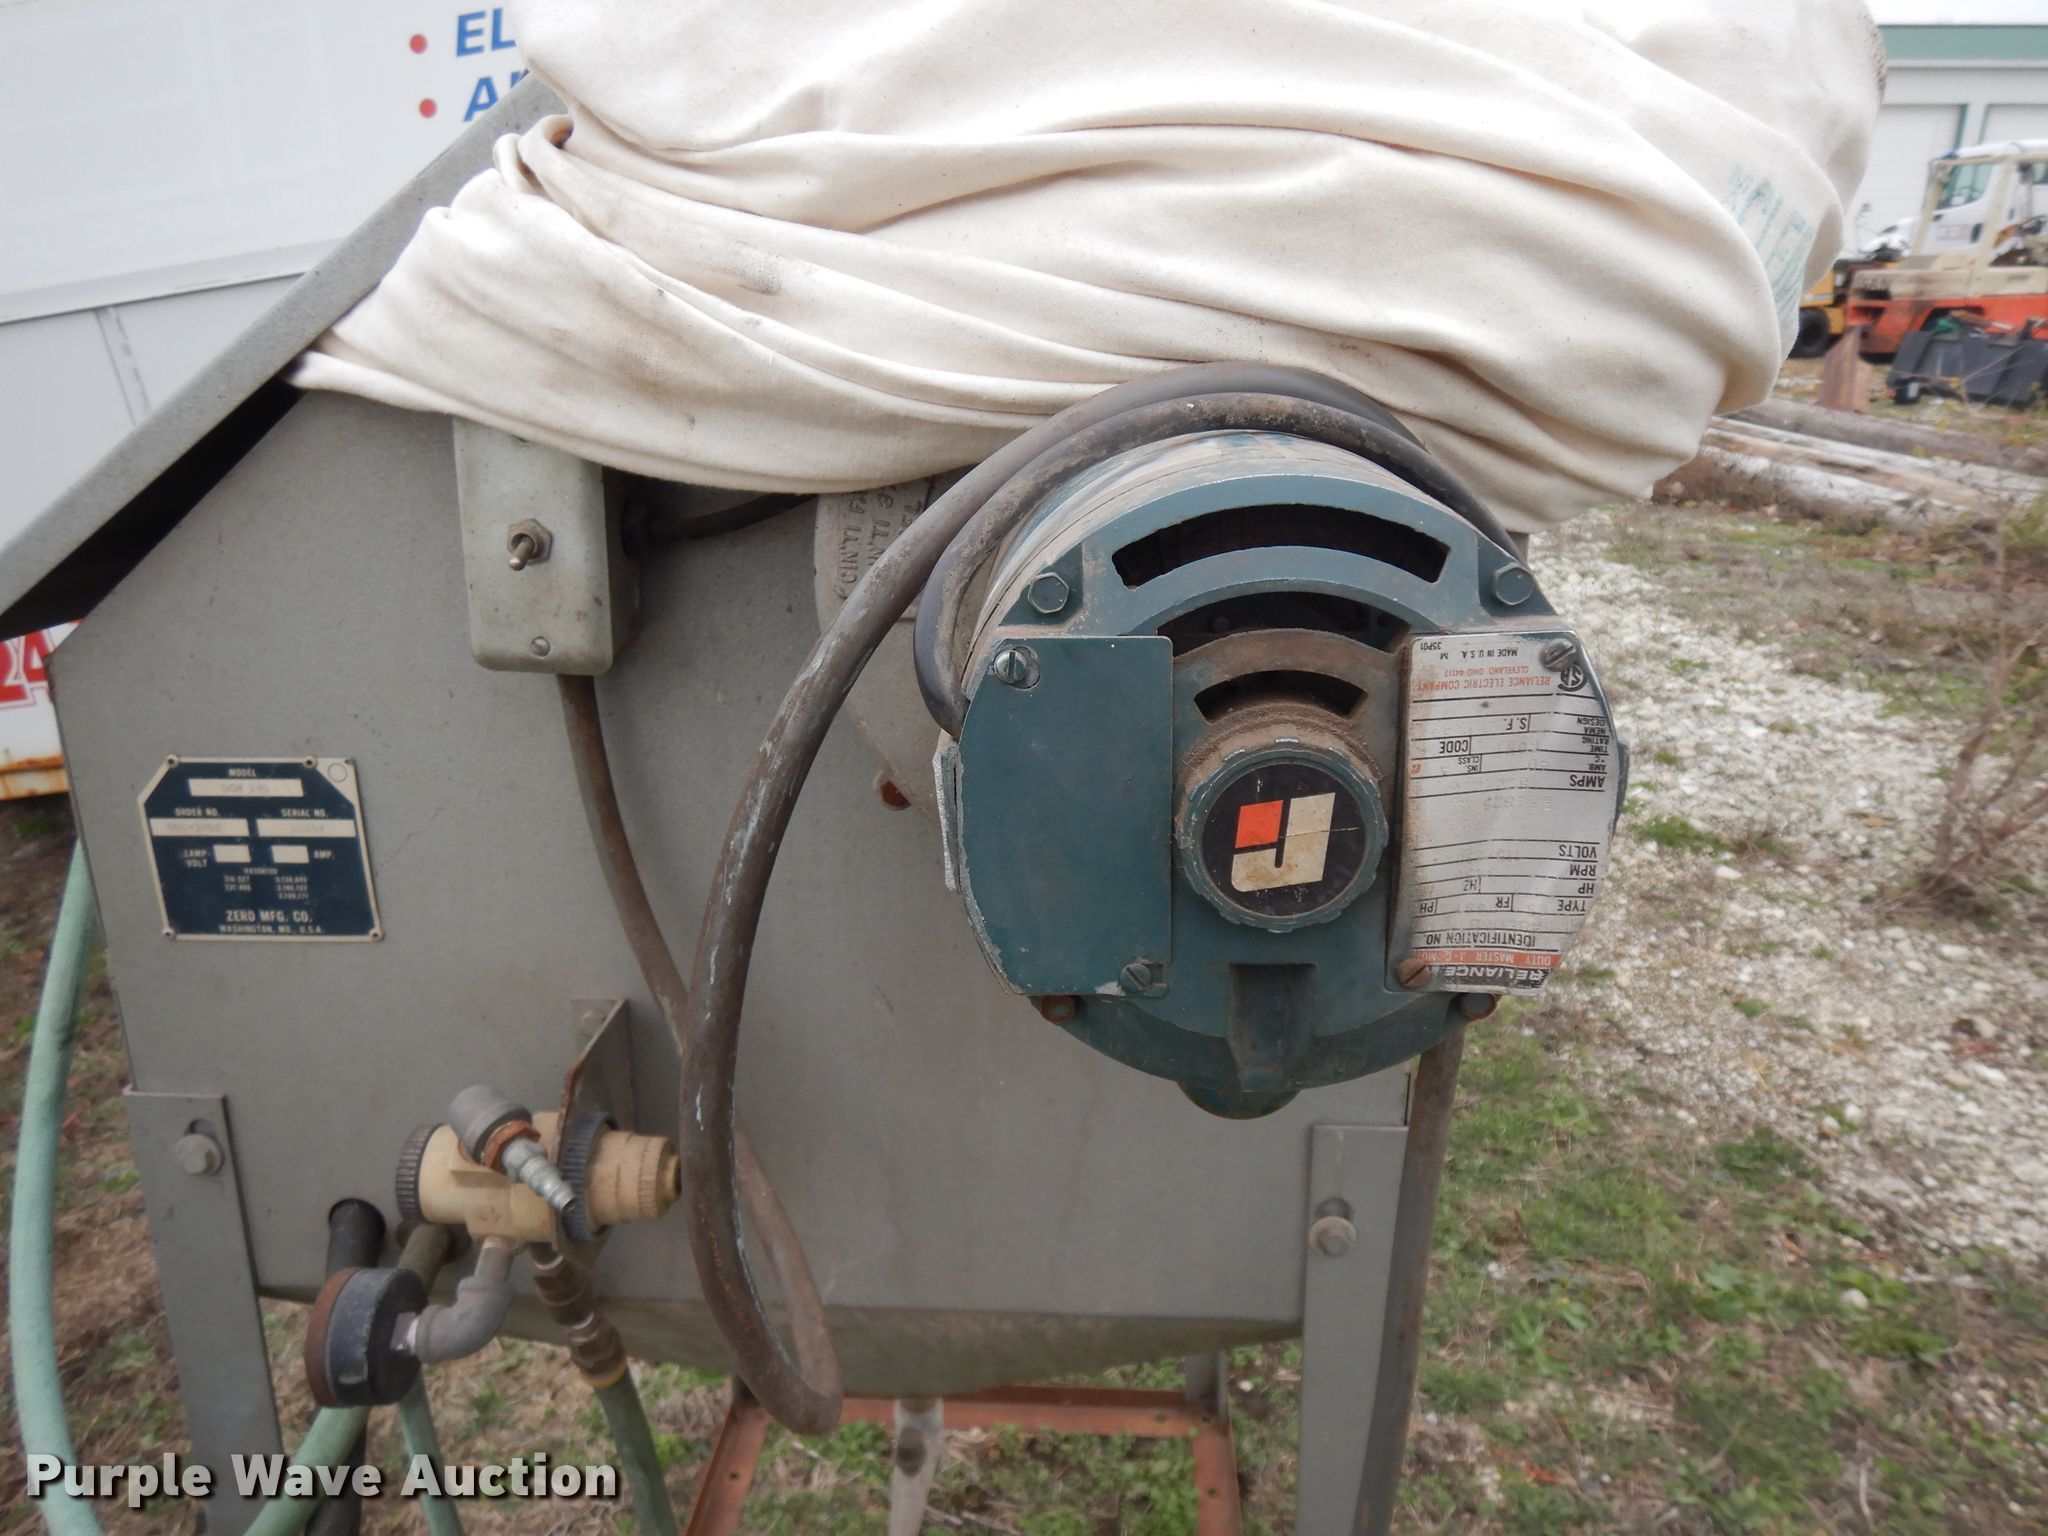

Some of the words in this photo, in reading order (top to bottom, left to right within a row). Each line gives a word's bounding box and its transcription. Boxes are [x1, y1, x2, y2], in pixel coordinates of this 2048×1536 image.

[1487, 650, 1495, 658] IN
[1498, 649, 1519, 658] MADE
[1416, 679, 1460, 692] COMPANY
[1464, 677, 1505, 689] ELECTRIC
[1508, 675, 1552, 687] RELIANCE
[1577, 716, 1605, 726] DESIGN
[1583, 726, 1606, 735] NEMA
[1439, 740, 1469, 754] CODE
[1582, 736, 1610, 746] RATING
[1590, 744, 1608, 753] TIME
[1458, 756, 1480, 766] CLASS
[227, 767, 258, 778] MODEL
[1569, 774, 1605, 788] AMPS
[174, 807, 203, 818] ORDER
[280, 807, 312, 818] SERIAL
[1558, 844, 1598, 859] VOLTS
[1569, 864, 1597, 877] RPM
[1463, 879, 1478, 892] HZ
[1577, 882, 1595, 895] HP
[1419, 901, 1435, 914] PH
[1495, 896, 1510, 908] FR
[1557, 899, 1586, 912] TYPE
[225, 909, 256, 923] ZERO
[259, 909, 289, 923] MFG.
[292, 910, 313, 923] CO.
[1446, 931, 1536, 947] IDENTIFICATION
[1475, 951, 1515, 964] MASTER
[1525, 955, 1552, 967] DUTY
[1444, 964, 1548, 982] RELIANCE
